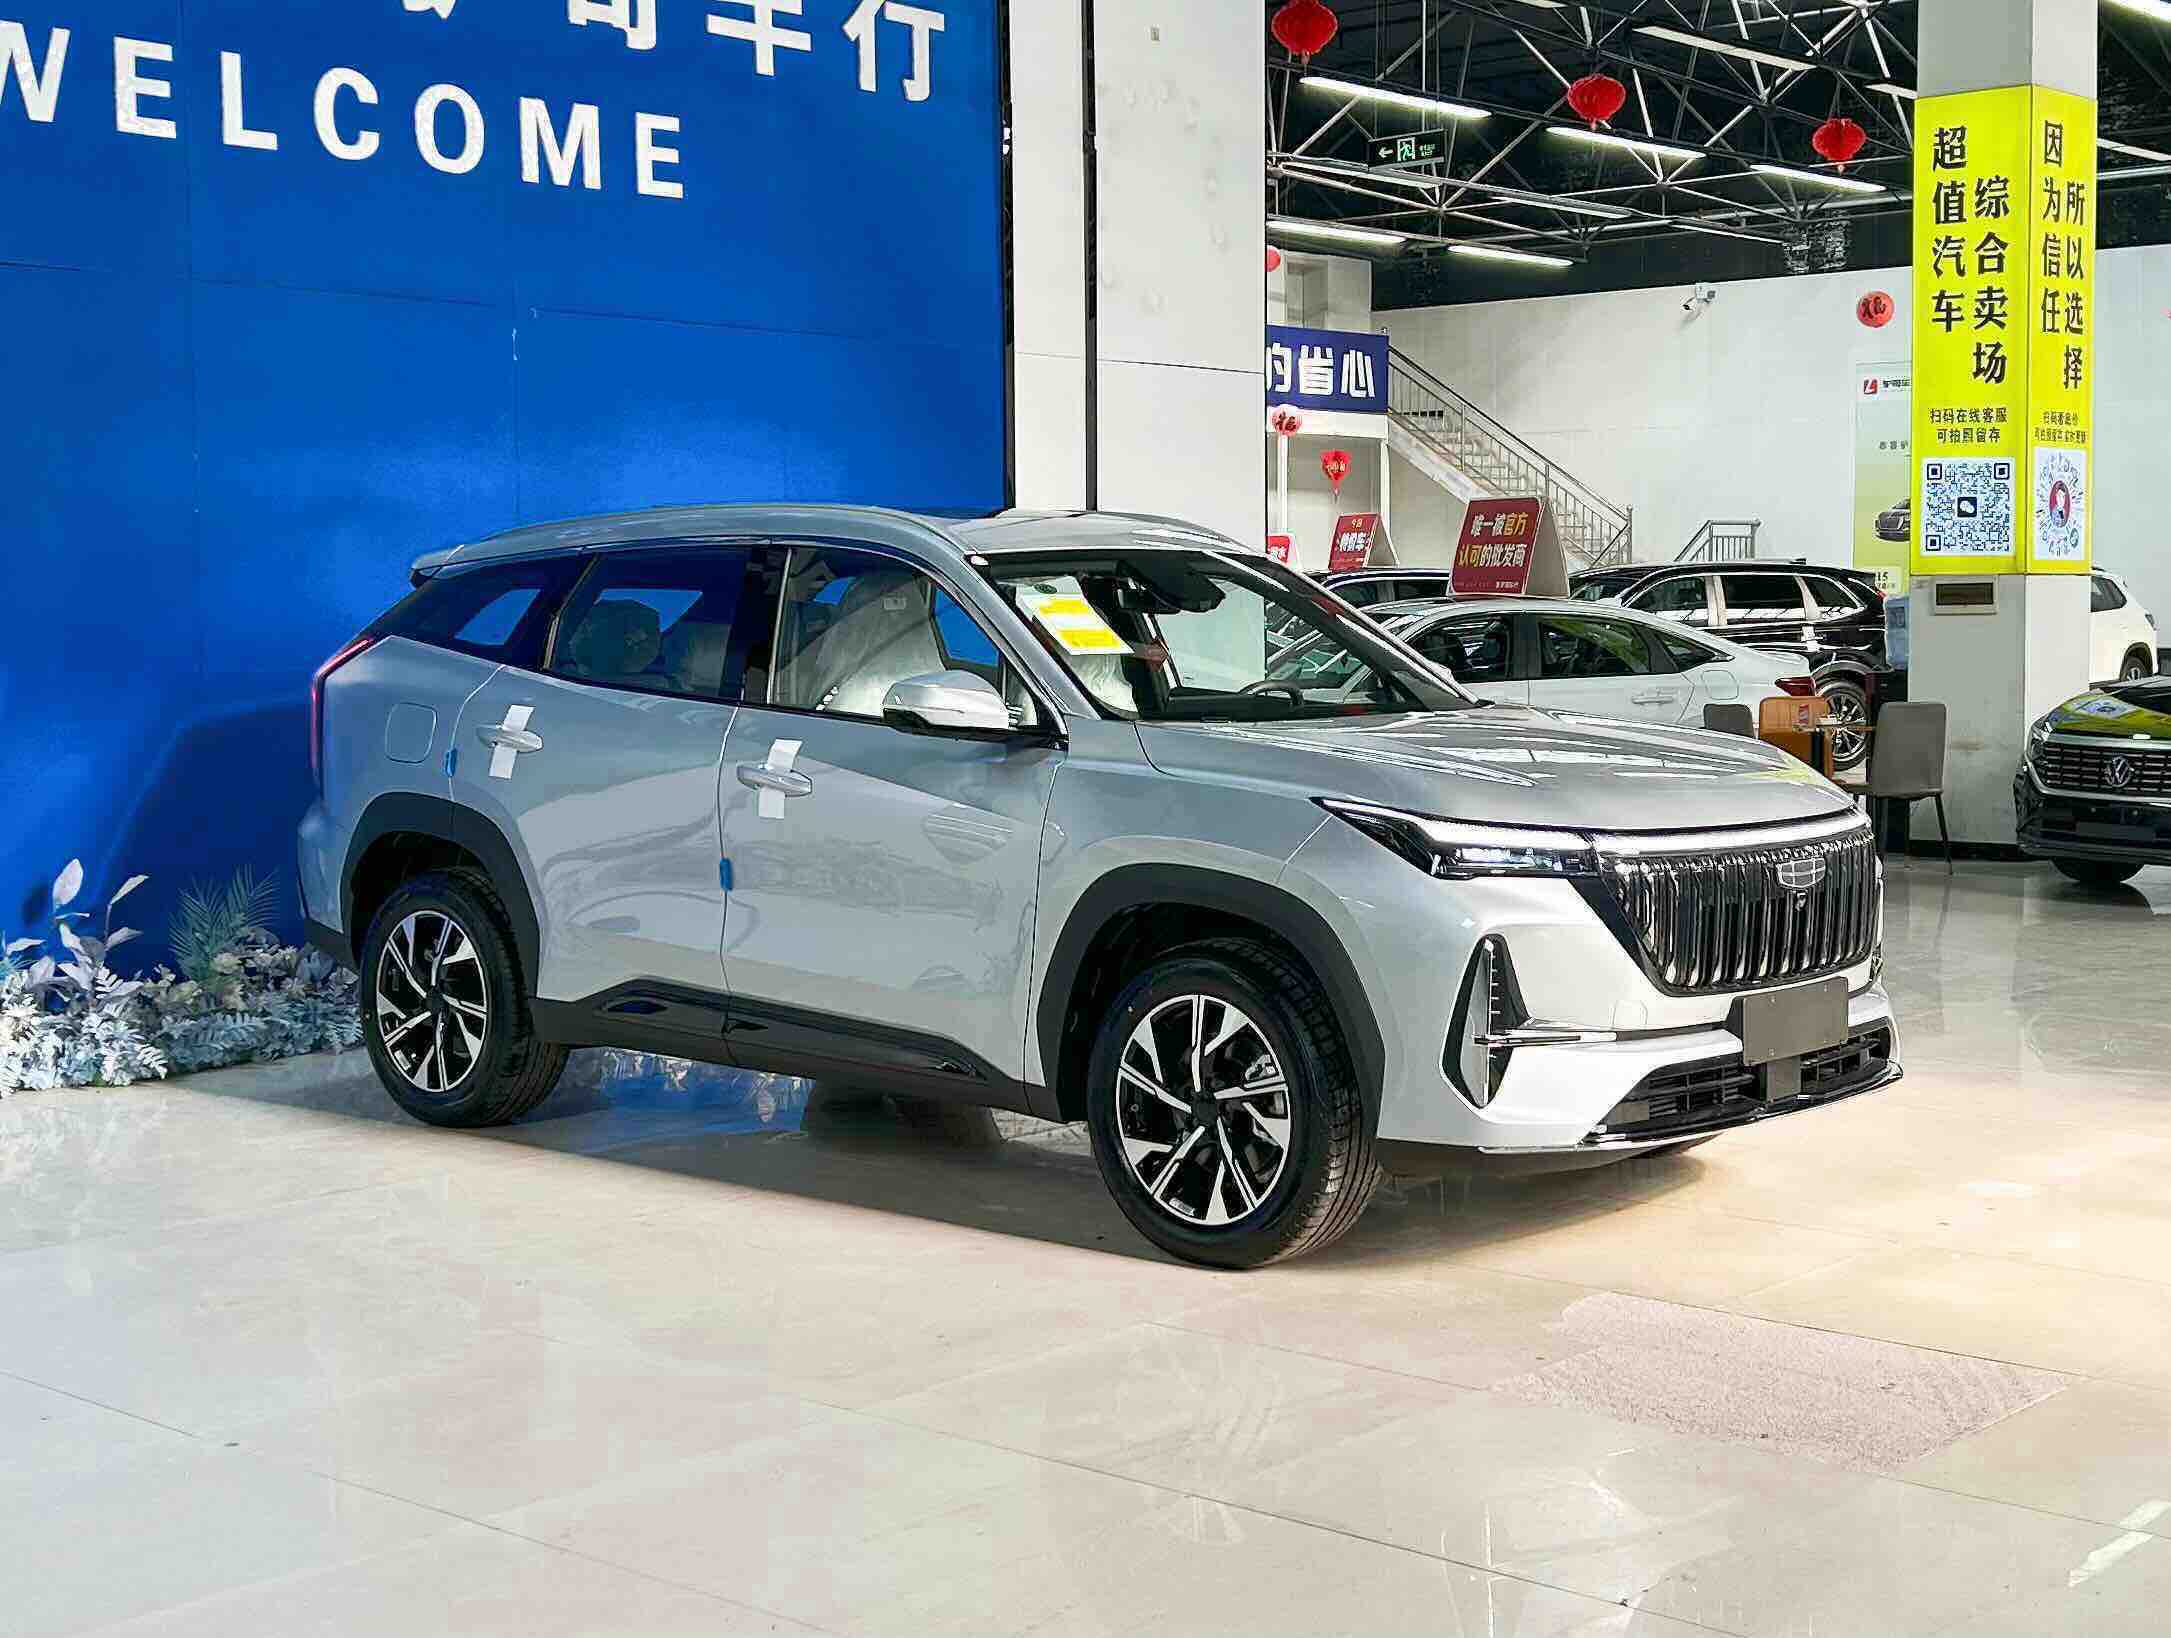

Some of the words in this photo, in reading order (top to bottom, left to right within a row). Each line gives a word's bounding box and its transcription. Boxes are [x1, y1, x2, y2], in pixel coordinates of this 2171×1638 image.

[0, 20, 685, 198] WELCOME
[404, 0, 945, 101] 车行
[1932, 125, 1968, 333] 超值汽车
[1972, 175, 2010, 384] 综合卖场
[2040, 119, 2064, 335] 因为信任
[2064, 181, 2086, 390] 所以选择
[1930, 407, 2008, 424] 扫码在线客服
[1937, 427, 2001, 443] 可拍照留存
[1457, 543, 1528, 567] 认可的批发商
